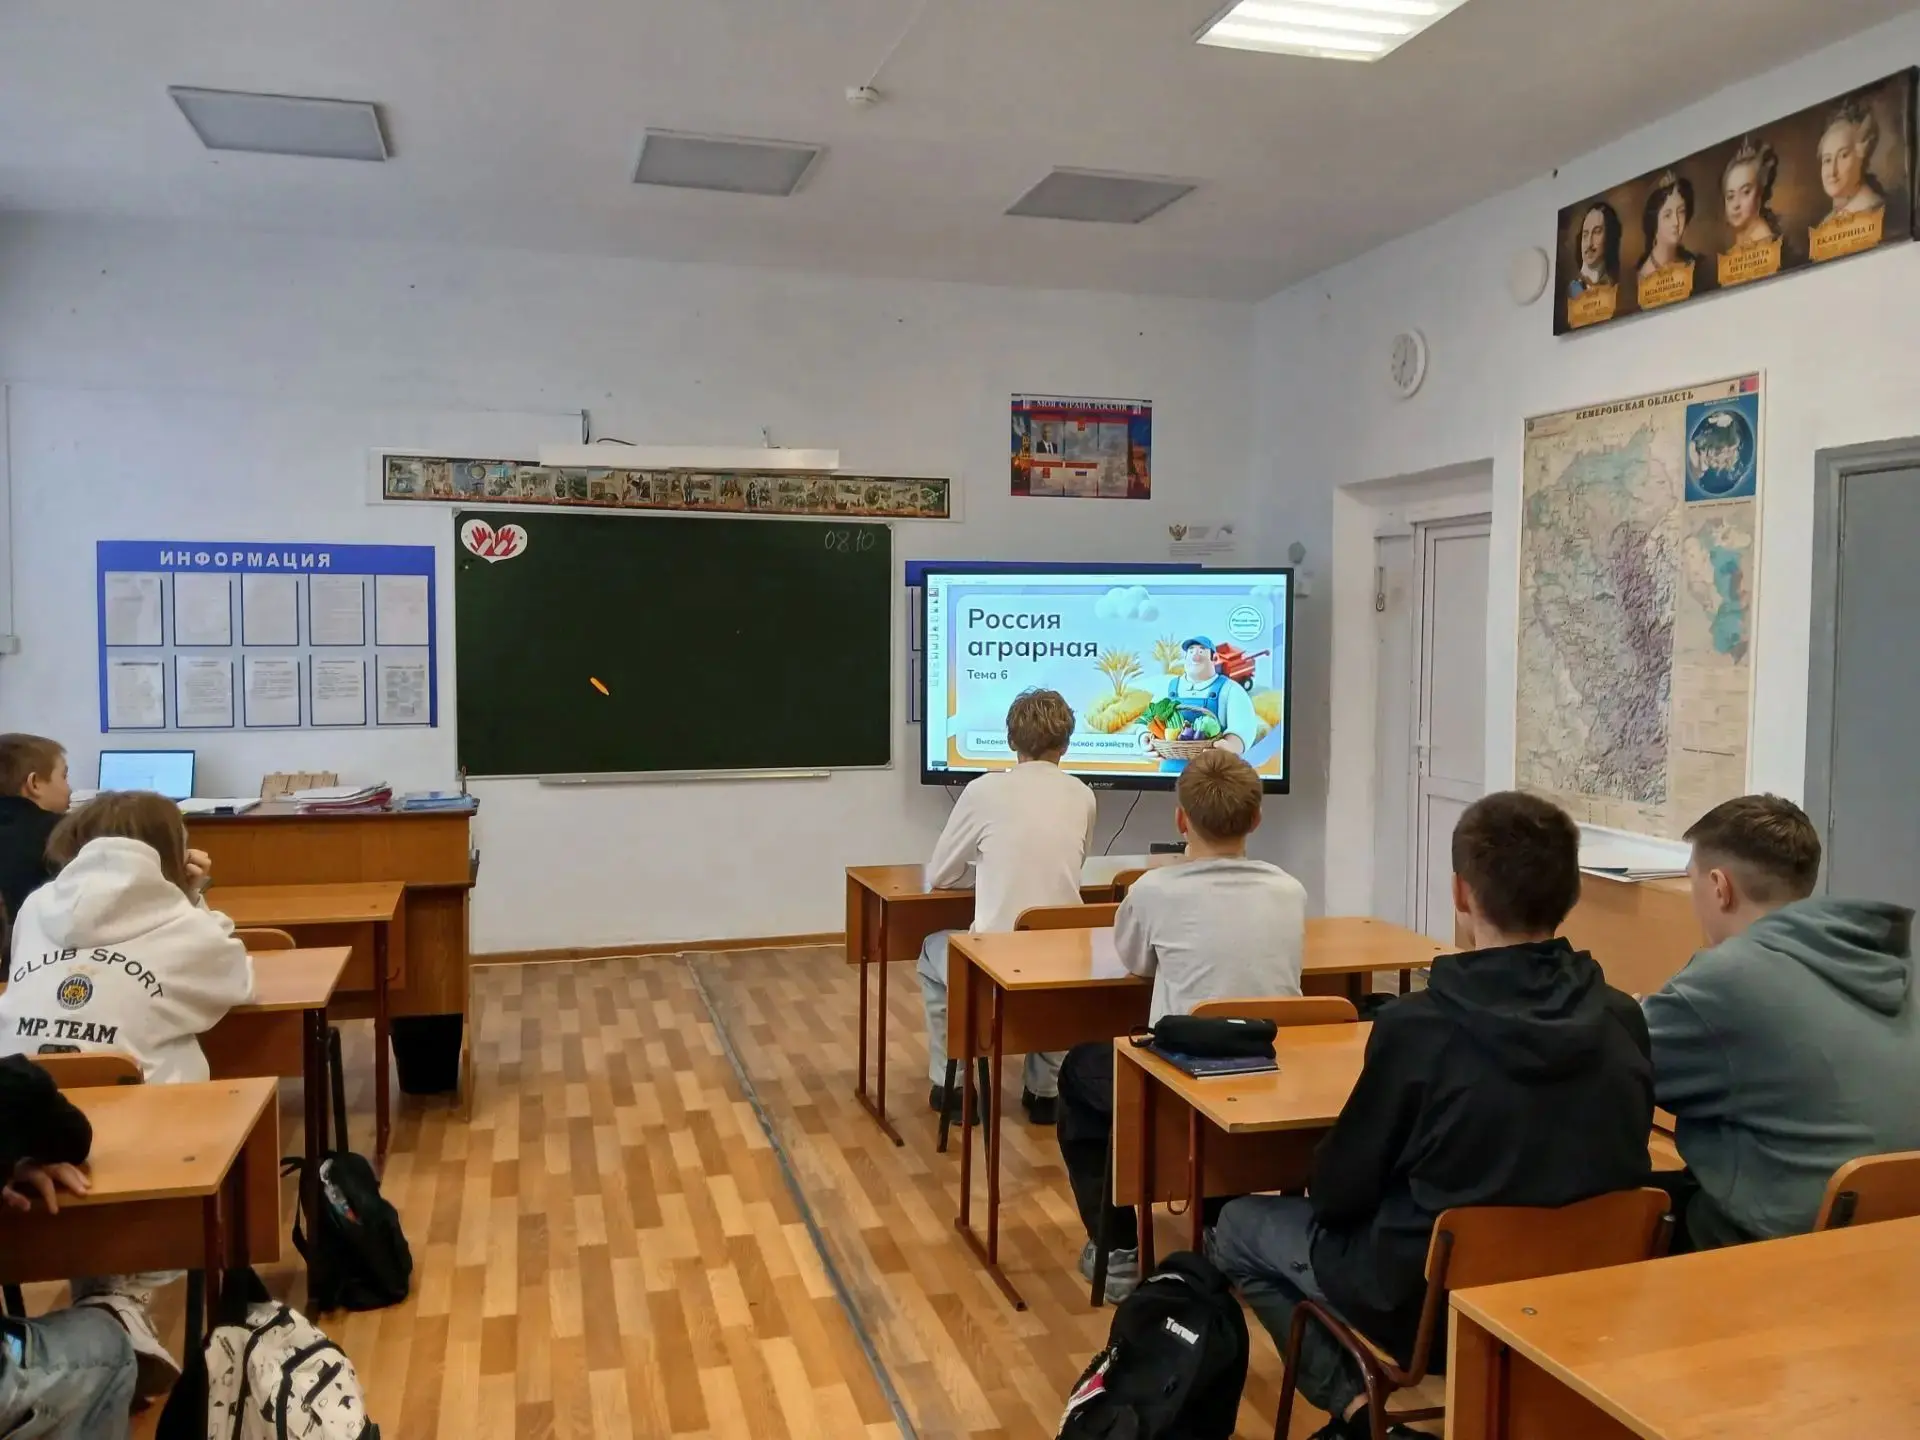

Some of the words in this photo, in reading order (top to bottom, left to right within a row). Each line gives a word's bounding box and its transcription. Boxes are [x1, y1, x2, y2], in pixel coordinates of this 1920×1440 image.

[1816, 228, 1867, 245] ЕКАТЕРИНА
[1036, 399, 1056, 409] МОЯ
[1058, 400, 1091, 410] СТРАНА
[1094, 402, 1128, 412] РОССИЯ
[1575, 400, 1645, 420] КЕМЕРОВСКАЯ
[1647, 391, 1694, 407] ОБЛАСТЬ
[159, 550, 332, 569] ИНФОРМАЦИЯ
[967, 607, 1061, 630] Россия
[966, 637, 1098, 662] аграрная
[966, 668, 997, 681] Тема
[1000, 668, 1008, 681] 6
[12, 948, 78, 983] CLUB
[89, 948, 164, 998] SPORT
